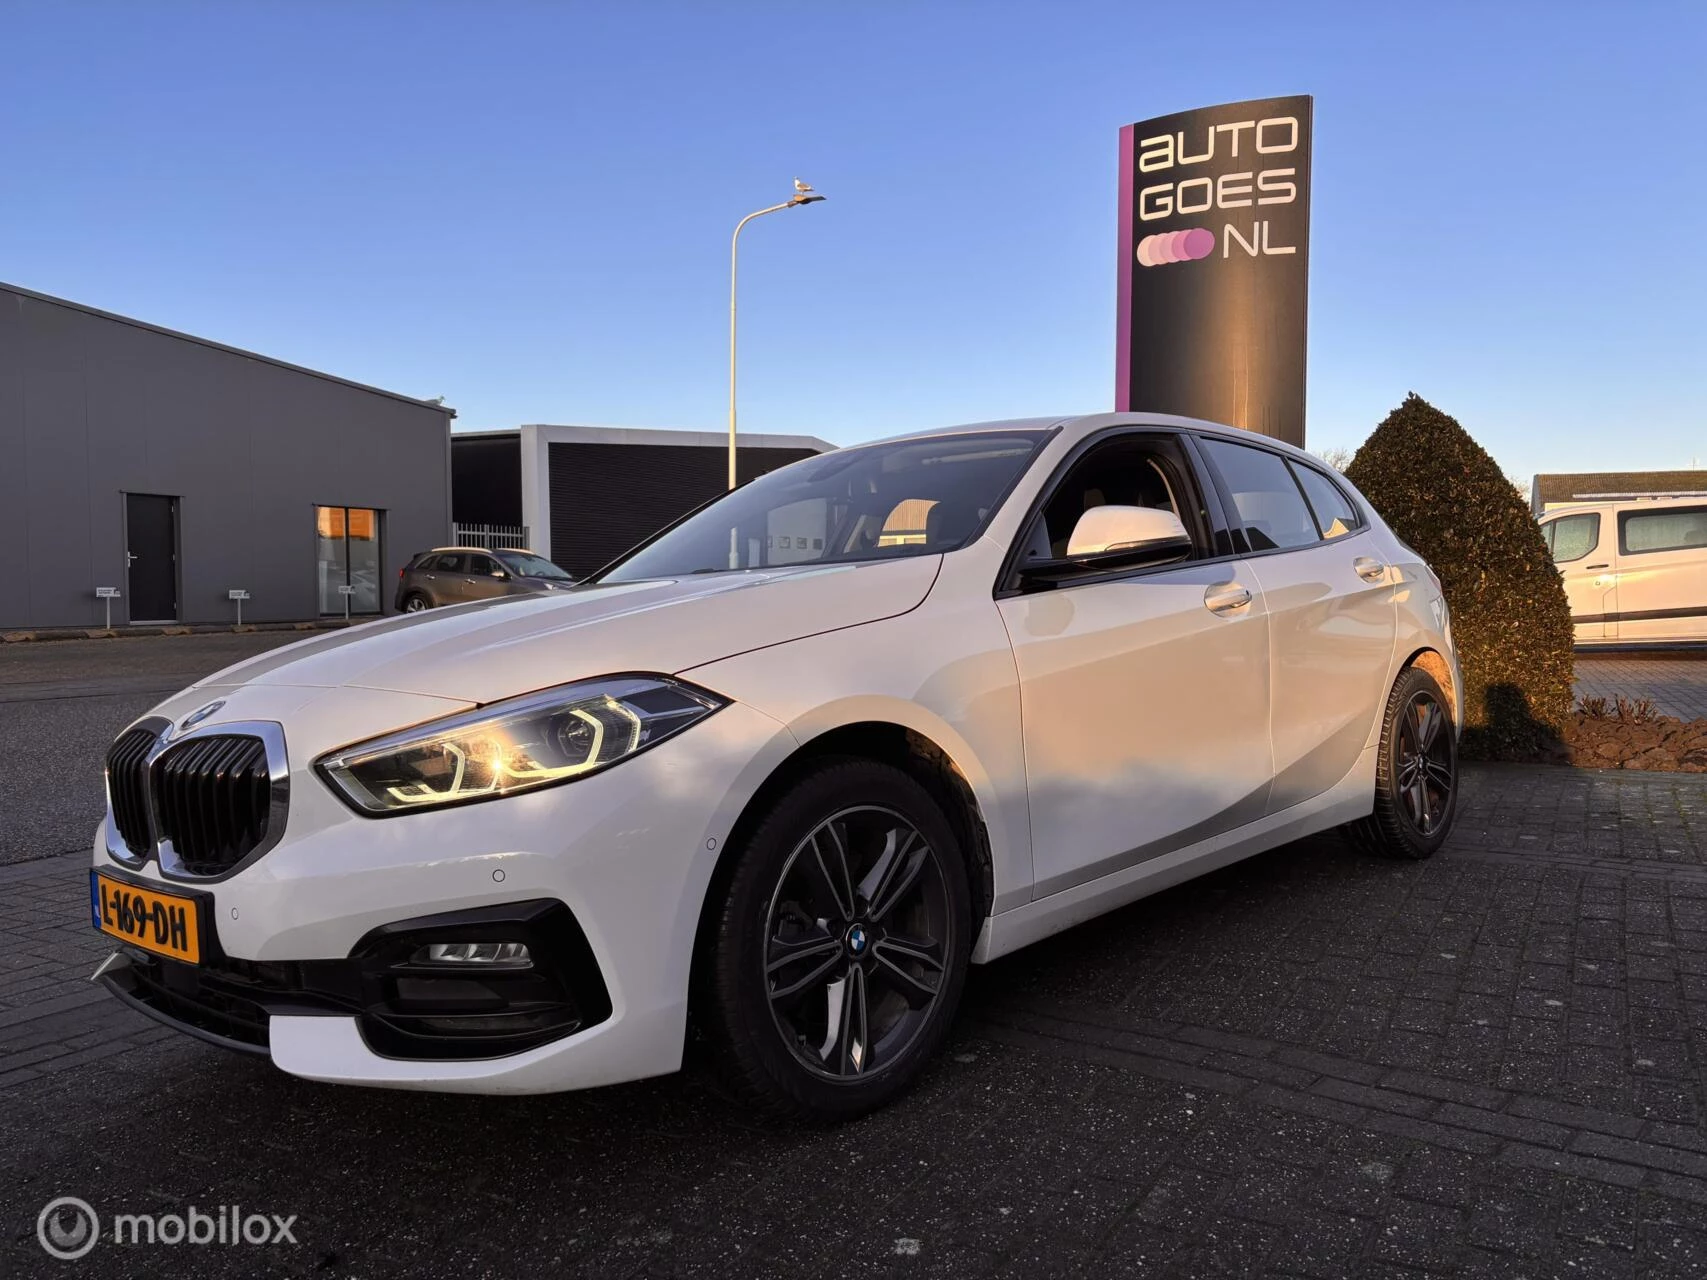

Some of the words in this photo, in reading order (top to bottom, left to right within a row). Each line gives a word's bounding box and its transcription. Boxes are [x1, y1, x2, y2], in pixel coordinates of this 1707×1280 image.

[1140, 168, 1296, 221] GOES
[1223, 220, 1296, 258] NL
[101, 884, 188, 952] L-169-DH
